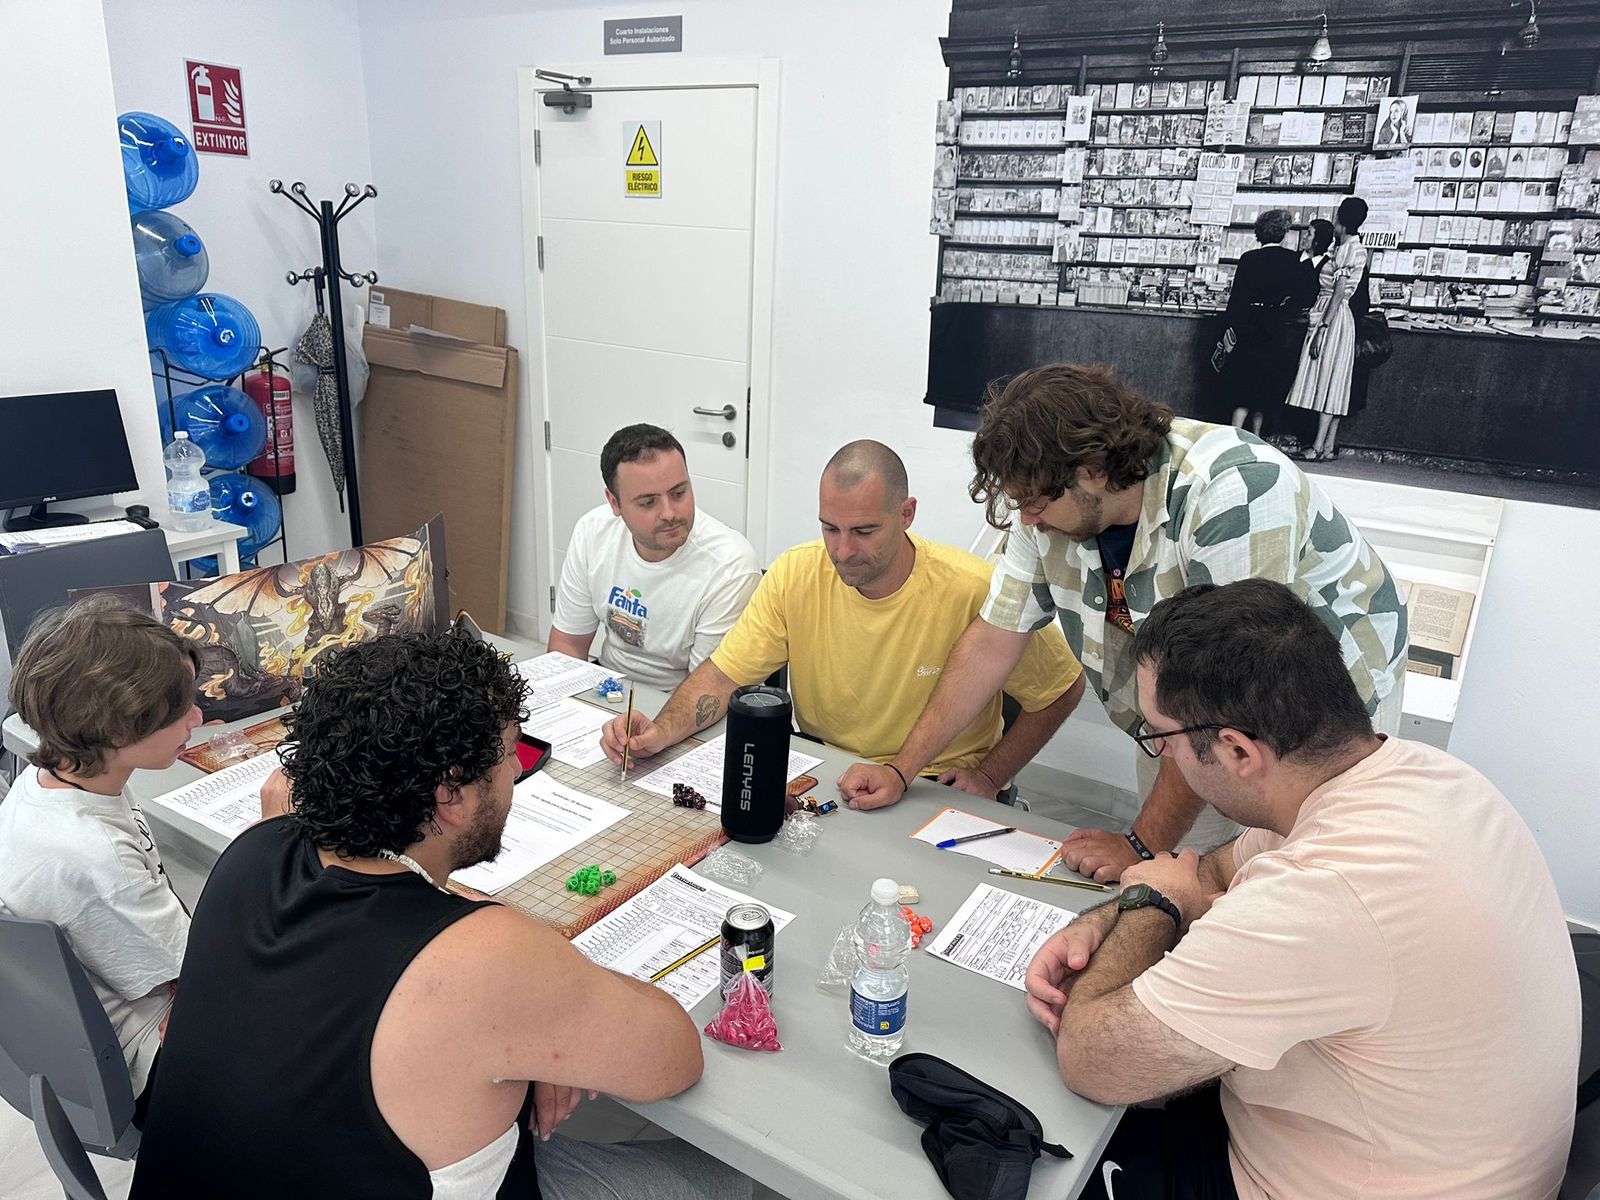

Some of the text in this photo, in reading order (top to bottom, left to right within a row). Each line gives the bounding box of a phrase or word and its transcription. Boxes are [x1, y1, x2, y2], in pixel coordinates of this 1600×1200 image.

[615, 26, 669, 36] Cuarto Instalaciones
[609, 35, 676, 45] Solo Personal Autorizado
[195, 131, 246, 151] EXTINTOR
[632, 172, 653, 182] RIESGO
[627, 180, 658, 191] ELÉCTRICO
[1364, 232, 1397, 247] LOTERIA
[608, 586, 648, 619] Fanta
[740, 743, 755, 811] LENYES
